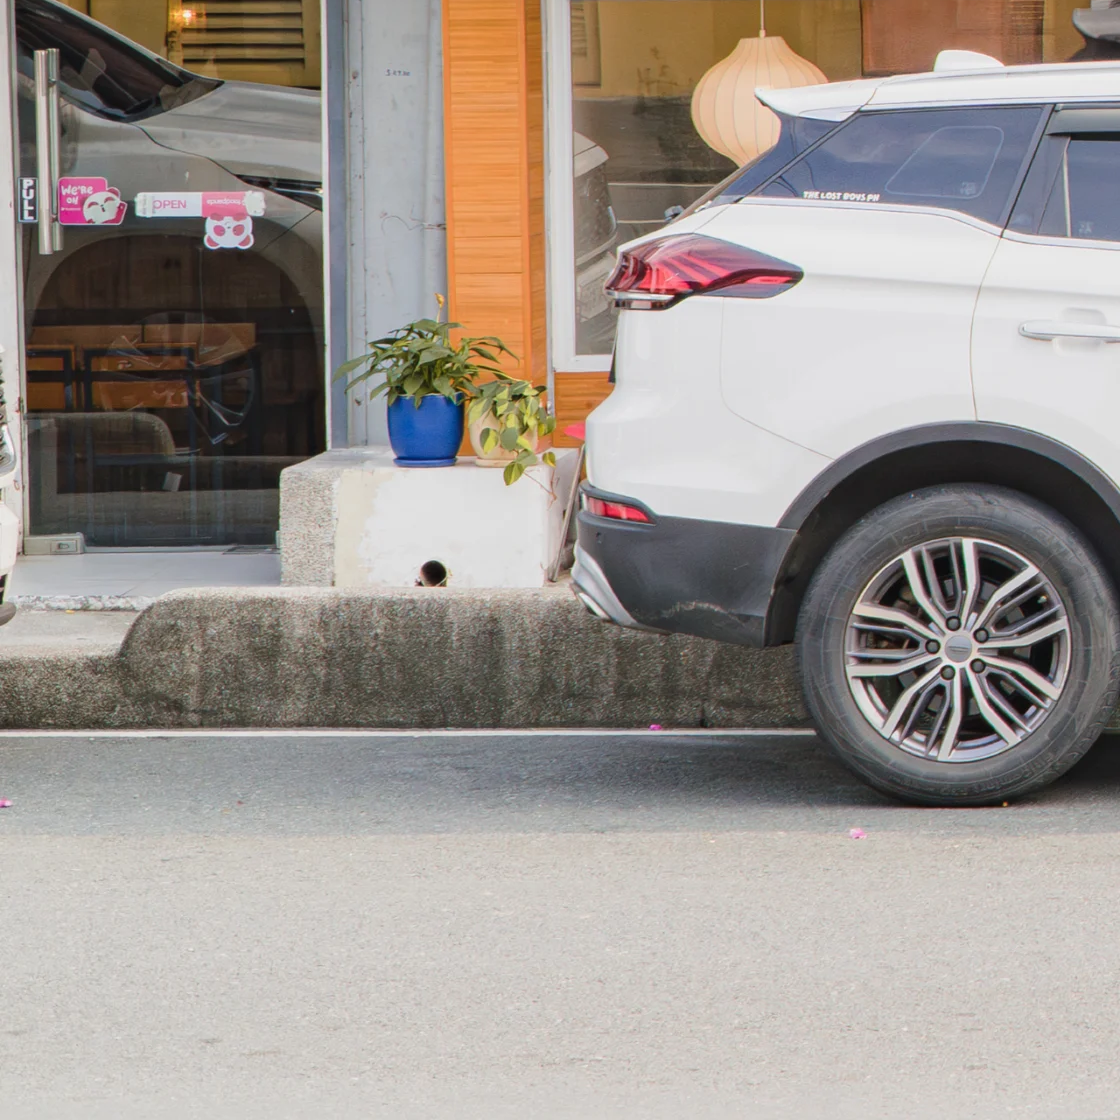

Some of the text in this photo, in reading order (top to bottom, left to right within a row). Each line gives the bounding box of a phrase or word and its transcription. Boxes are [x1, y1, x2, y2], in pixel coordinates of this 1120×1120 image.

[23, 179, 34, 220] PULL
[803, 191, 880, 202] THE LOST BOYS PH
[152, 199, 187, 209] OPEN
